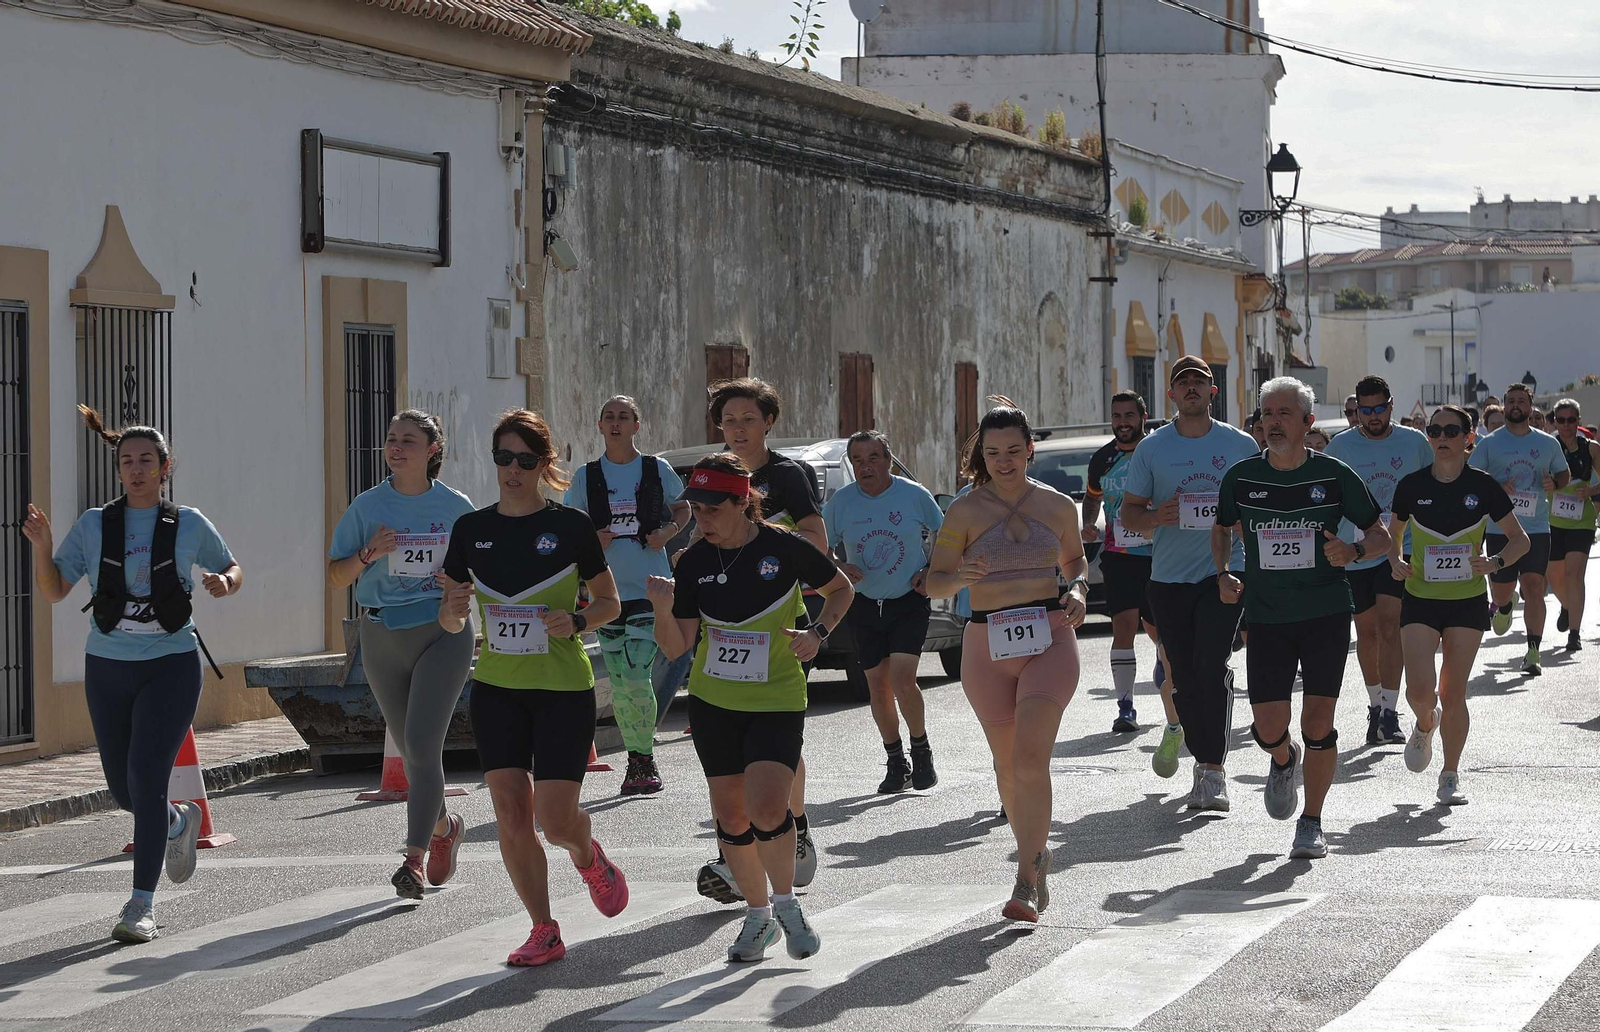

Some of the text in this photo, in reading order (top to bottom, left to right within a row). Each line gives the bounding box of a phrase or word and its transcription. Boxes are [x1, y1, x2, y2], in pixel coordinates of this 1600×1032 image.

[1513, 498, 1529, 508] 220
[1560, 502, 1575, 511] 216
[1193, 506, 1218, 518] 169
[1250, 518, 1324, 532] Ladbrokes
[861, 529, 899, 542] CARRERA
[886, 541, 905, 575] POPULAR
[1272, 543, 1300, 556] 225
[404, 550, 432, 563] 241
[1436, 558, 1461, 569] 222
[498, 622, 530, 638] 217
[1004, 624, 1034, 642] 191
[718, 647, 750, 664] 227
